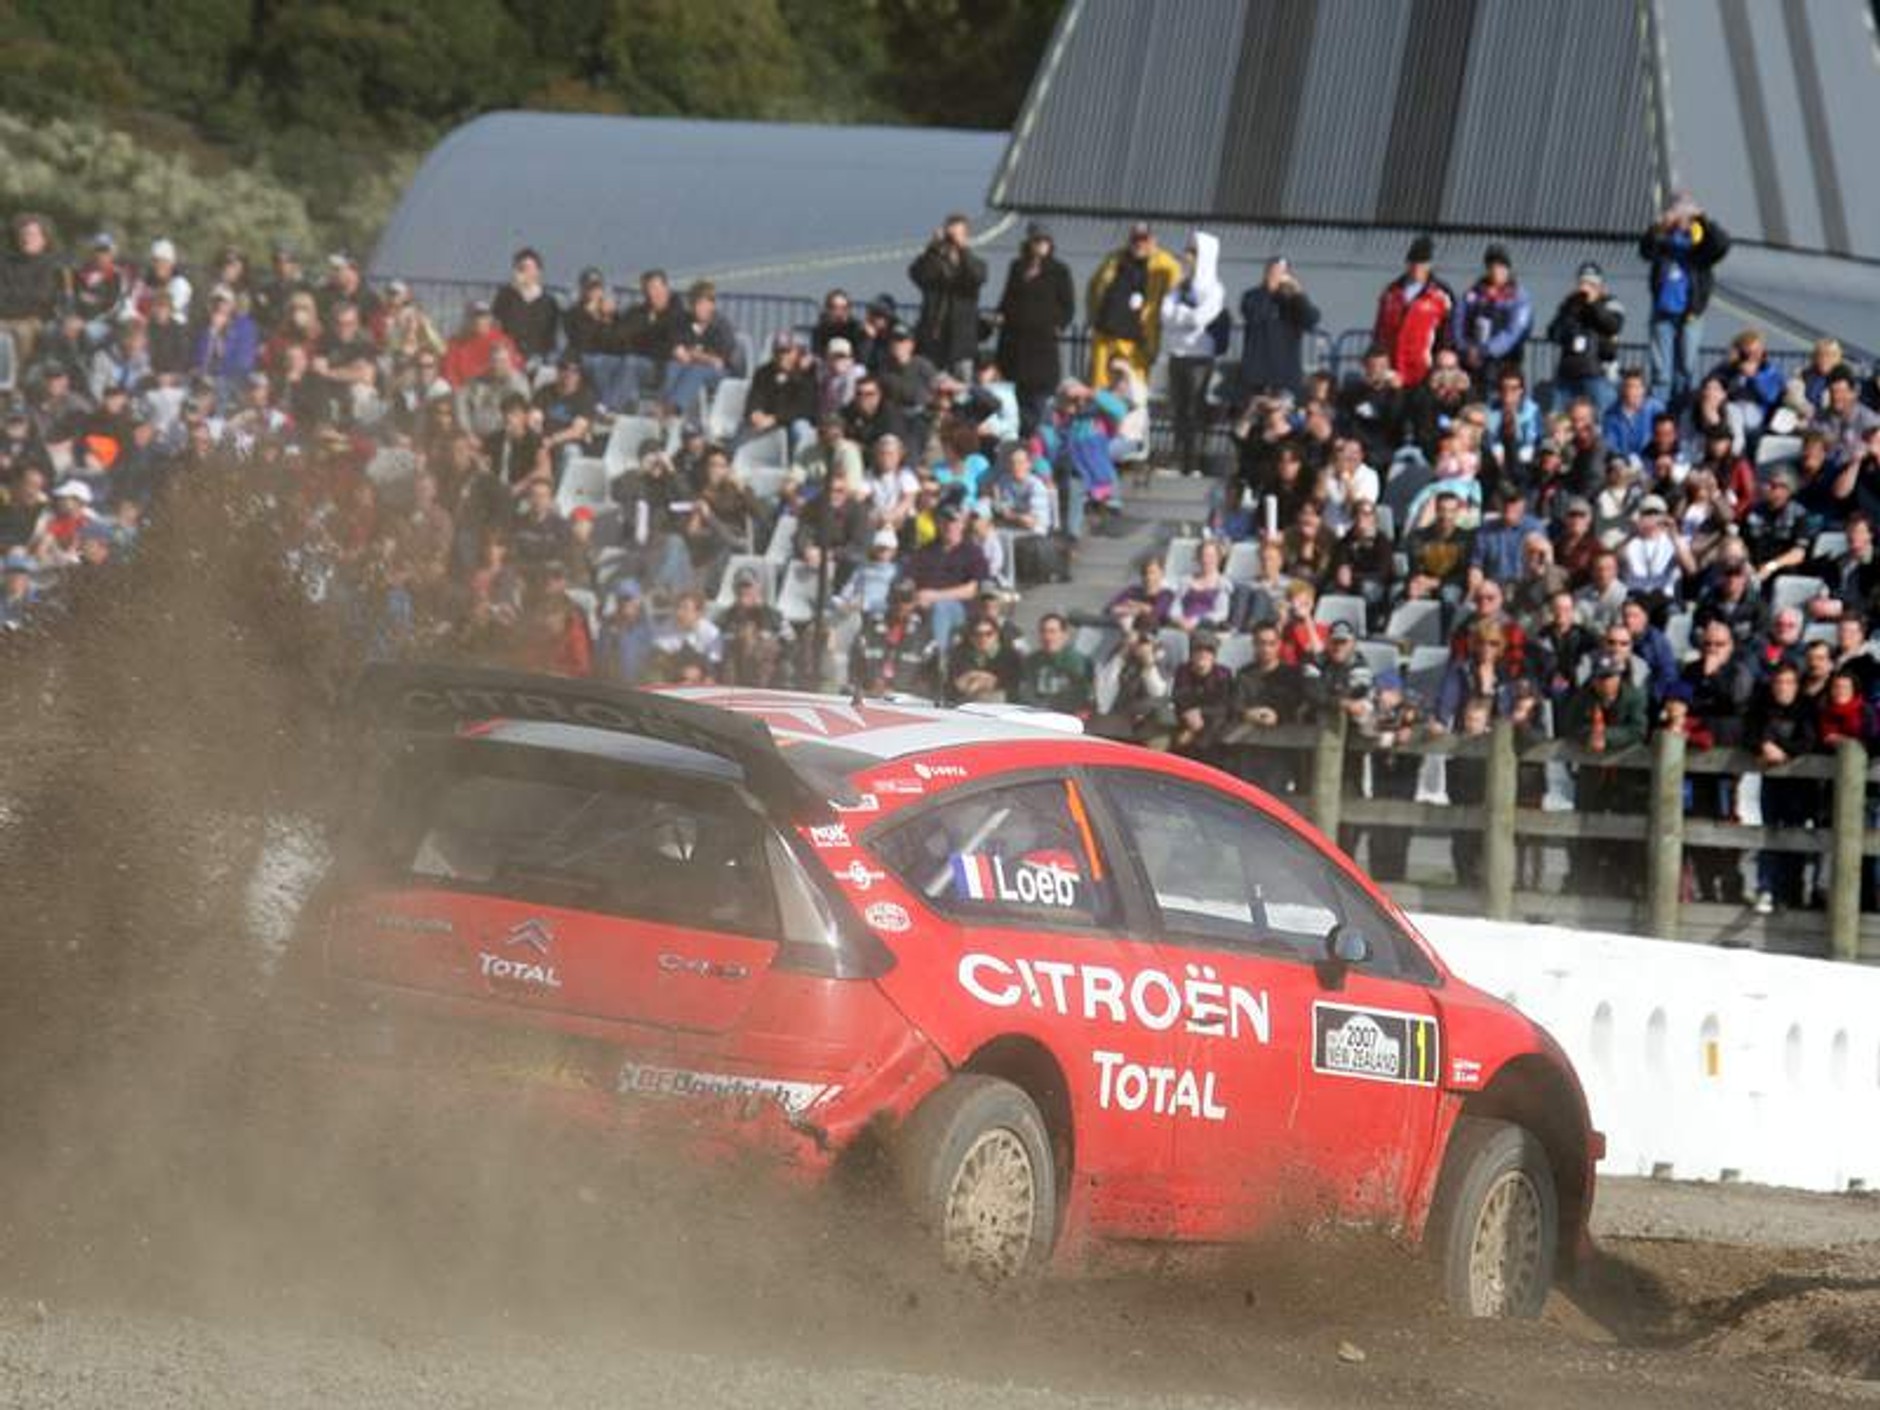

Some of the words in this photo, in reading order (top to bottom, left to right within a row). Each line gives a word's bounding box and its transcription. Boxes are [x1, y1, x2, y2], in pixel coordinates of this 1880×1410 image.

[994, 855, 1075, 907] Loeb
[479, 952, 562, 987] TOTAL
[958, 953, 1270, 1044] CITROËN
[1347, 1025, 1377, 1047] 2007
[1093, 1050, 1227, 1120] TOTAL
